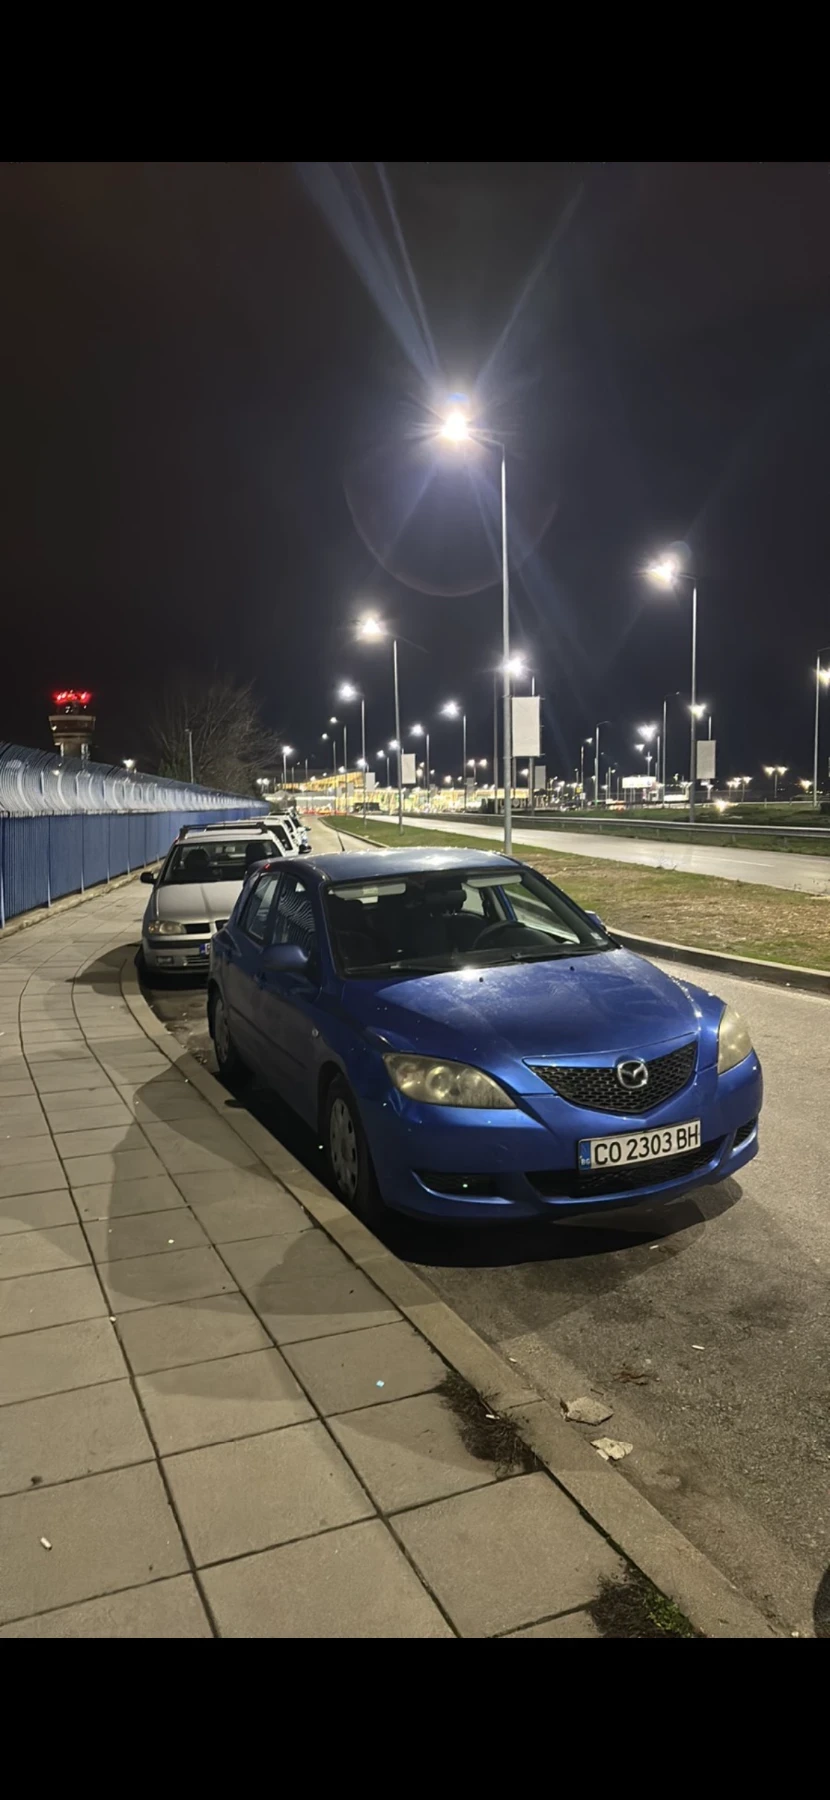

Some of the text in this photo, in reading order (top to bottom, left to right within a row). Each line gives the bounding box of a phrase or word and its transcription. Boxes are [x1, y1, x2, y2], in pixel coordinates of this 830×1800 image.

[594, 1124, 698, 1165] CO 2303 BH
